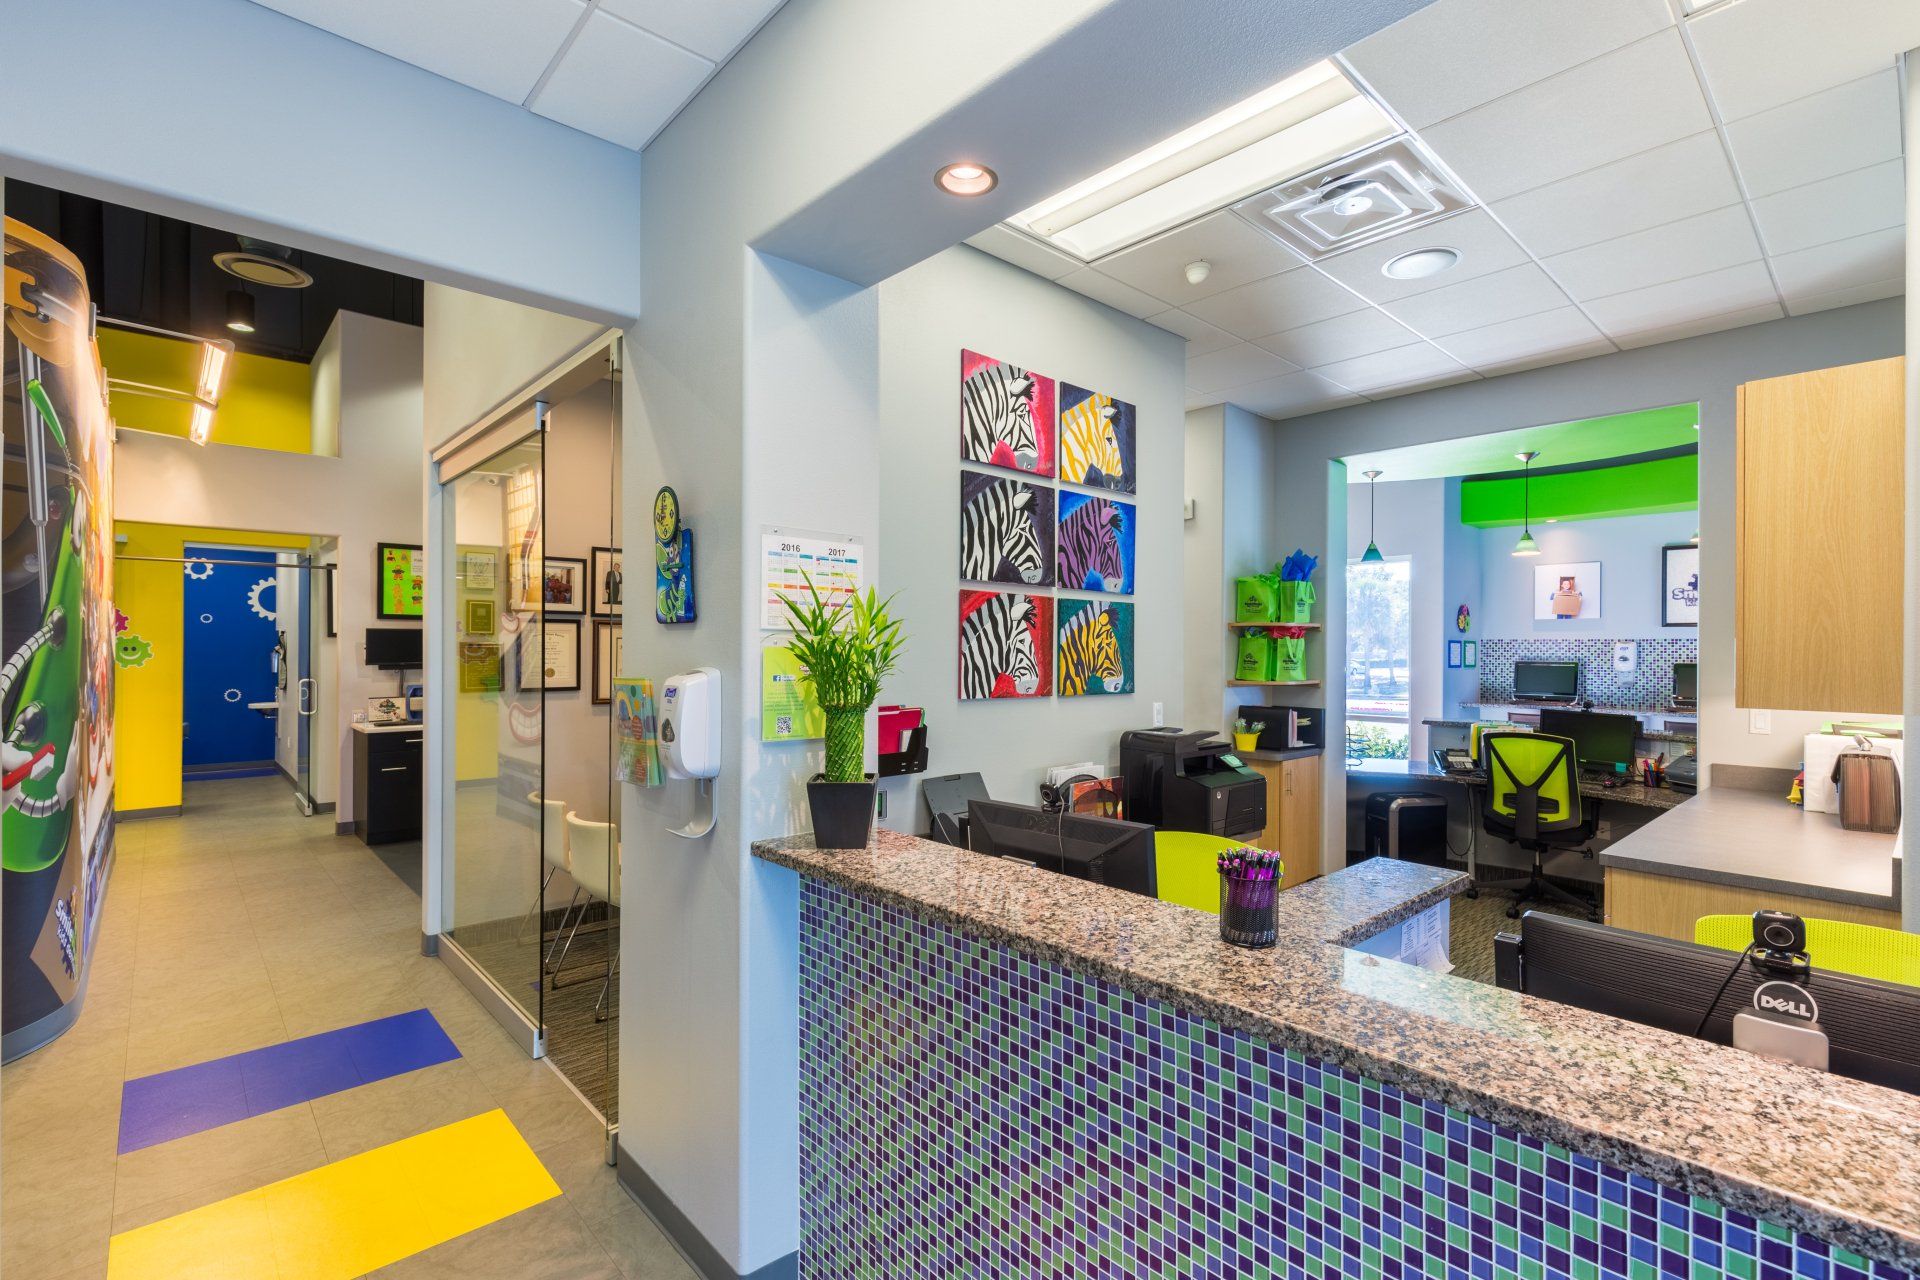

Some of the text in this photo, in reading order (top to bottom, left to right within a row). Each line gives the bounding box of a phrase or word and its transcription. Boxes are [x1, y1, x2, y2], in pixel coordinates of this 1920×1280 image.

[781, 543, 801, 553] 2016
[828, 547, 846, 557] 2017
[1760, 994, 1811, 1018] DELL
